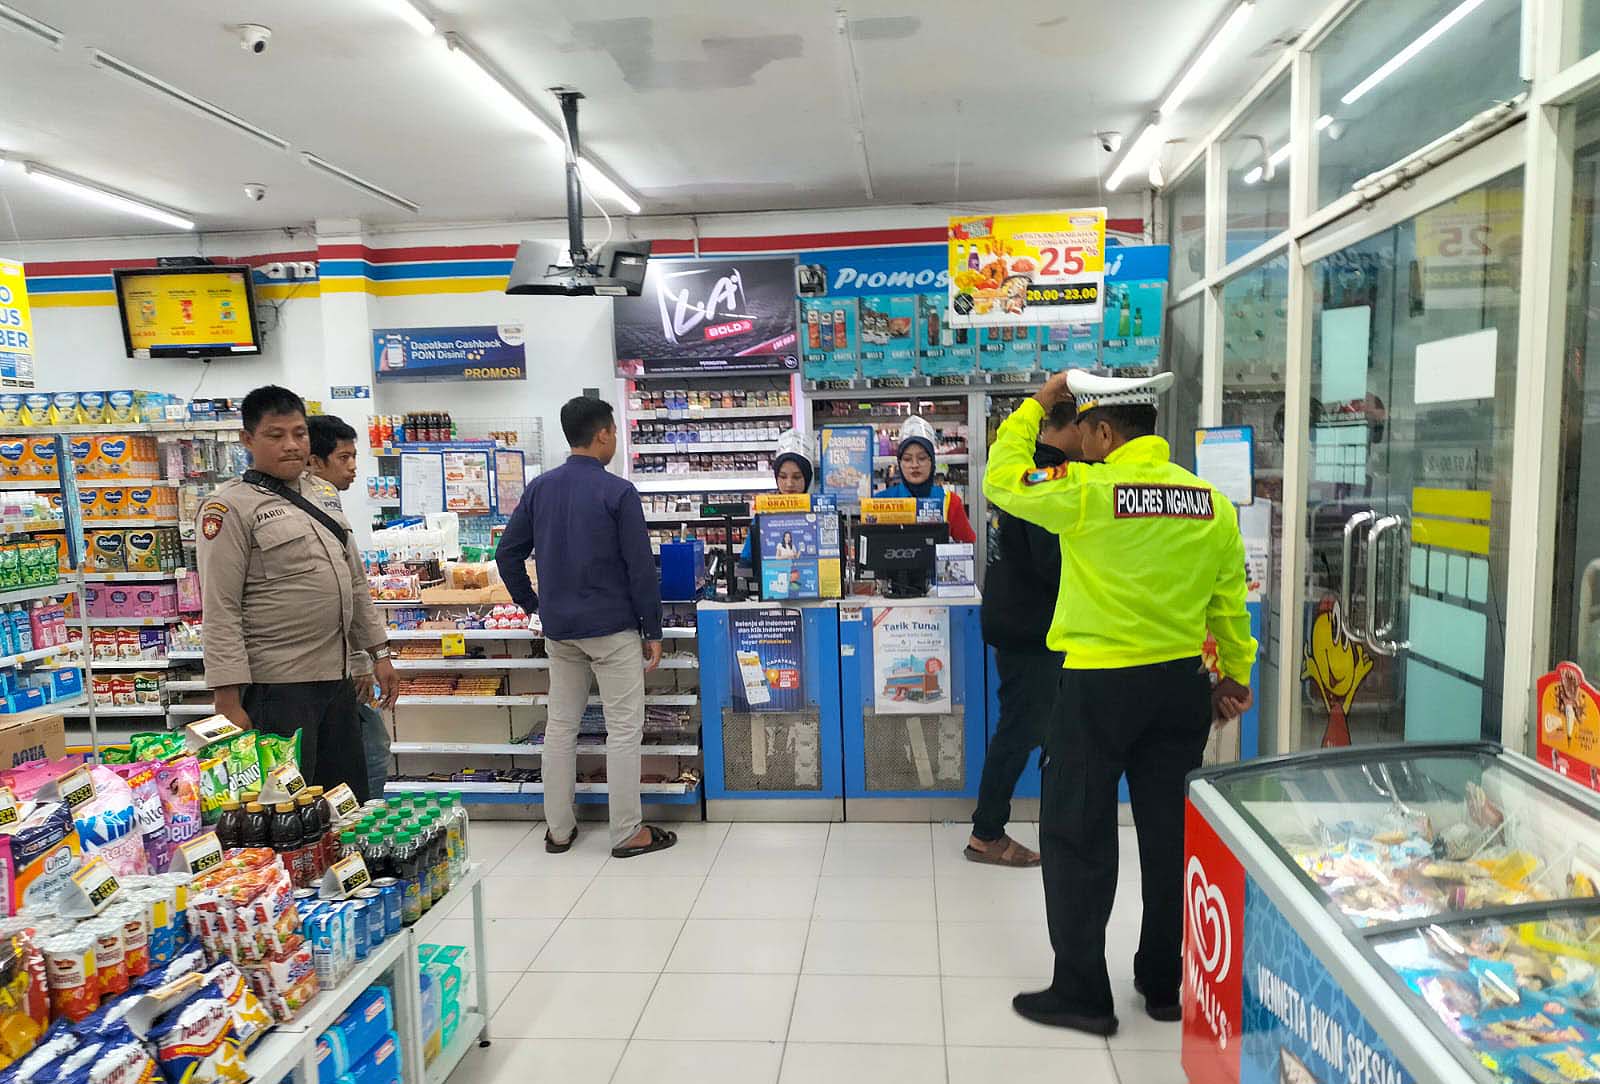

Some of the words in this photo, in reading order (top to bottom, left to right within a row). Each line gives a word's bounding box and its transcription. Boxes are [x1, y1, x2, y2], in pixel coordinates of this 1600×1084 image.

[1039, 246, 1084, 276] 25
[708, 323, 742, 337] BOLD
[411, 341, 454, 351] Dapatkan
[455, 338, 502, 349] Cashback
[411, 351, 436, 360] POIN
[437, 350, 466, 359] Disini!
[1117, 487, 1163, 514] POLRES
[1166, 490, 1212, 515] NGANJUK
[256, 508, 286, 523] PARDI
[884, 548, 921, 559] acer
[735, 620, 758, 628] Belanja
[883, 621, 909, 632] Tarik
[912, 621, 940, 631] Tunai
[1187, 949, 1228, 1050] WALL'S
[1310, 1003, 1344, 1073] BIKIN
